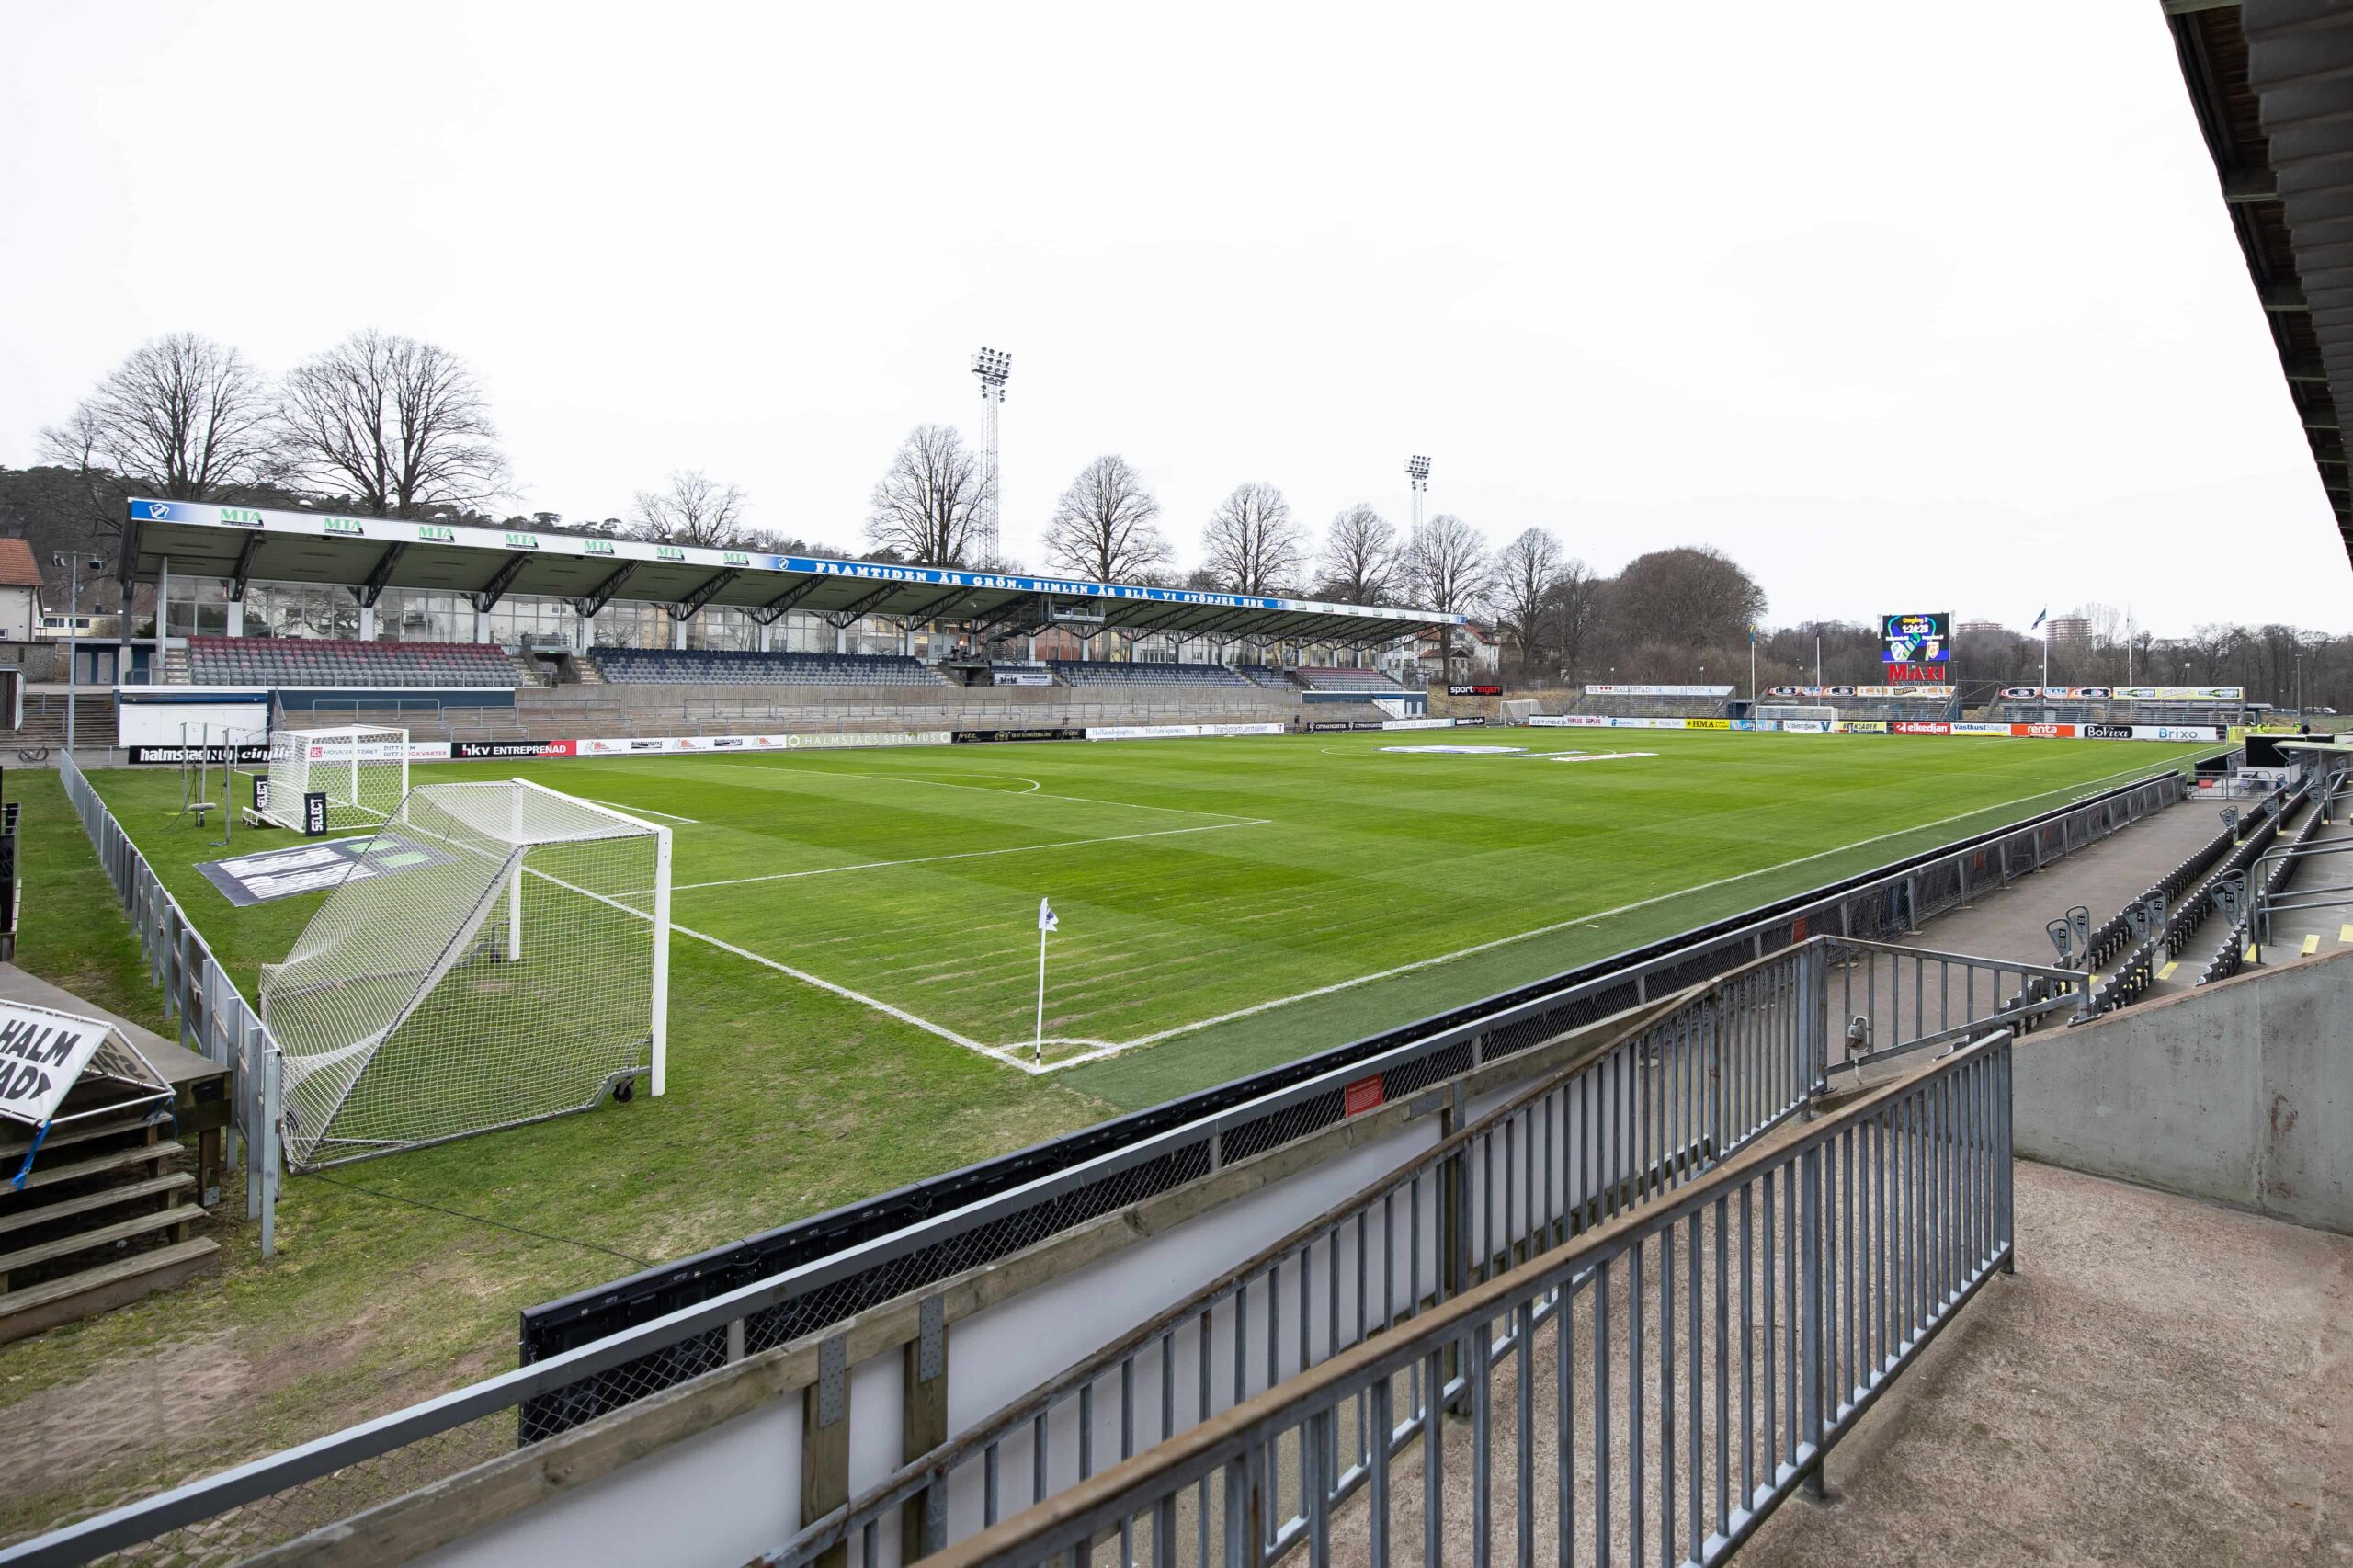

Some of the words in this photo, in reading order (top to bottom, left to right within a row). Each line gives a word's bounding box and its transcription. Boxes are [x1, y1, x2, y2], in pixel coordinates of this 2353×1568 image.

[221, 508, 262, 523] MTA
[324, 517, 363, 531] MTA
[419, 526, 453, 540] MTA
[506, 533, 538, 547] MTA
[585, 540, 615, 553] MTA
[657, 546, 685, 559] MTA
[815, 562, 927, 582] FRAMTIDEN
[939, 572, 962, 585] ÄR
[1033, 581, 1089, 595] HIMLEN
[1097, 585, 1116, 597] ÄR
[1163, 592, 1176, 601] VI
[1184, 593, 1236, 606] STÖDJER
[1243, 598, 1265, 608] HBK
[1889, 664, 1946, 681] MAXI
[1450, 685, 1501, 696] sportringen
[1907, 722, 1948, 733] elkedjan
[2027, 724, 2058, 733] renta
[2087, 726, 2130, 738] BoViva
[2159, 728, 2199, 739] Brixo
[804, 735, 879, 745] HALMSTADS
[462, 744, 490, 756] hkv
[493, 744, 567, 756] ENTREPRENAD
[256, 780, 267, 808] SELECT
[311, 798, 324, 832] SELECT
[0, 1019, 82, 1068] HALM
